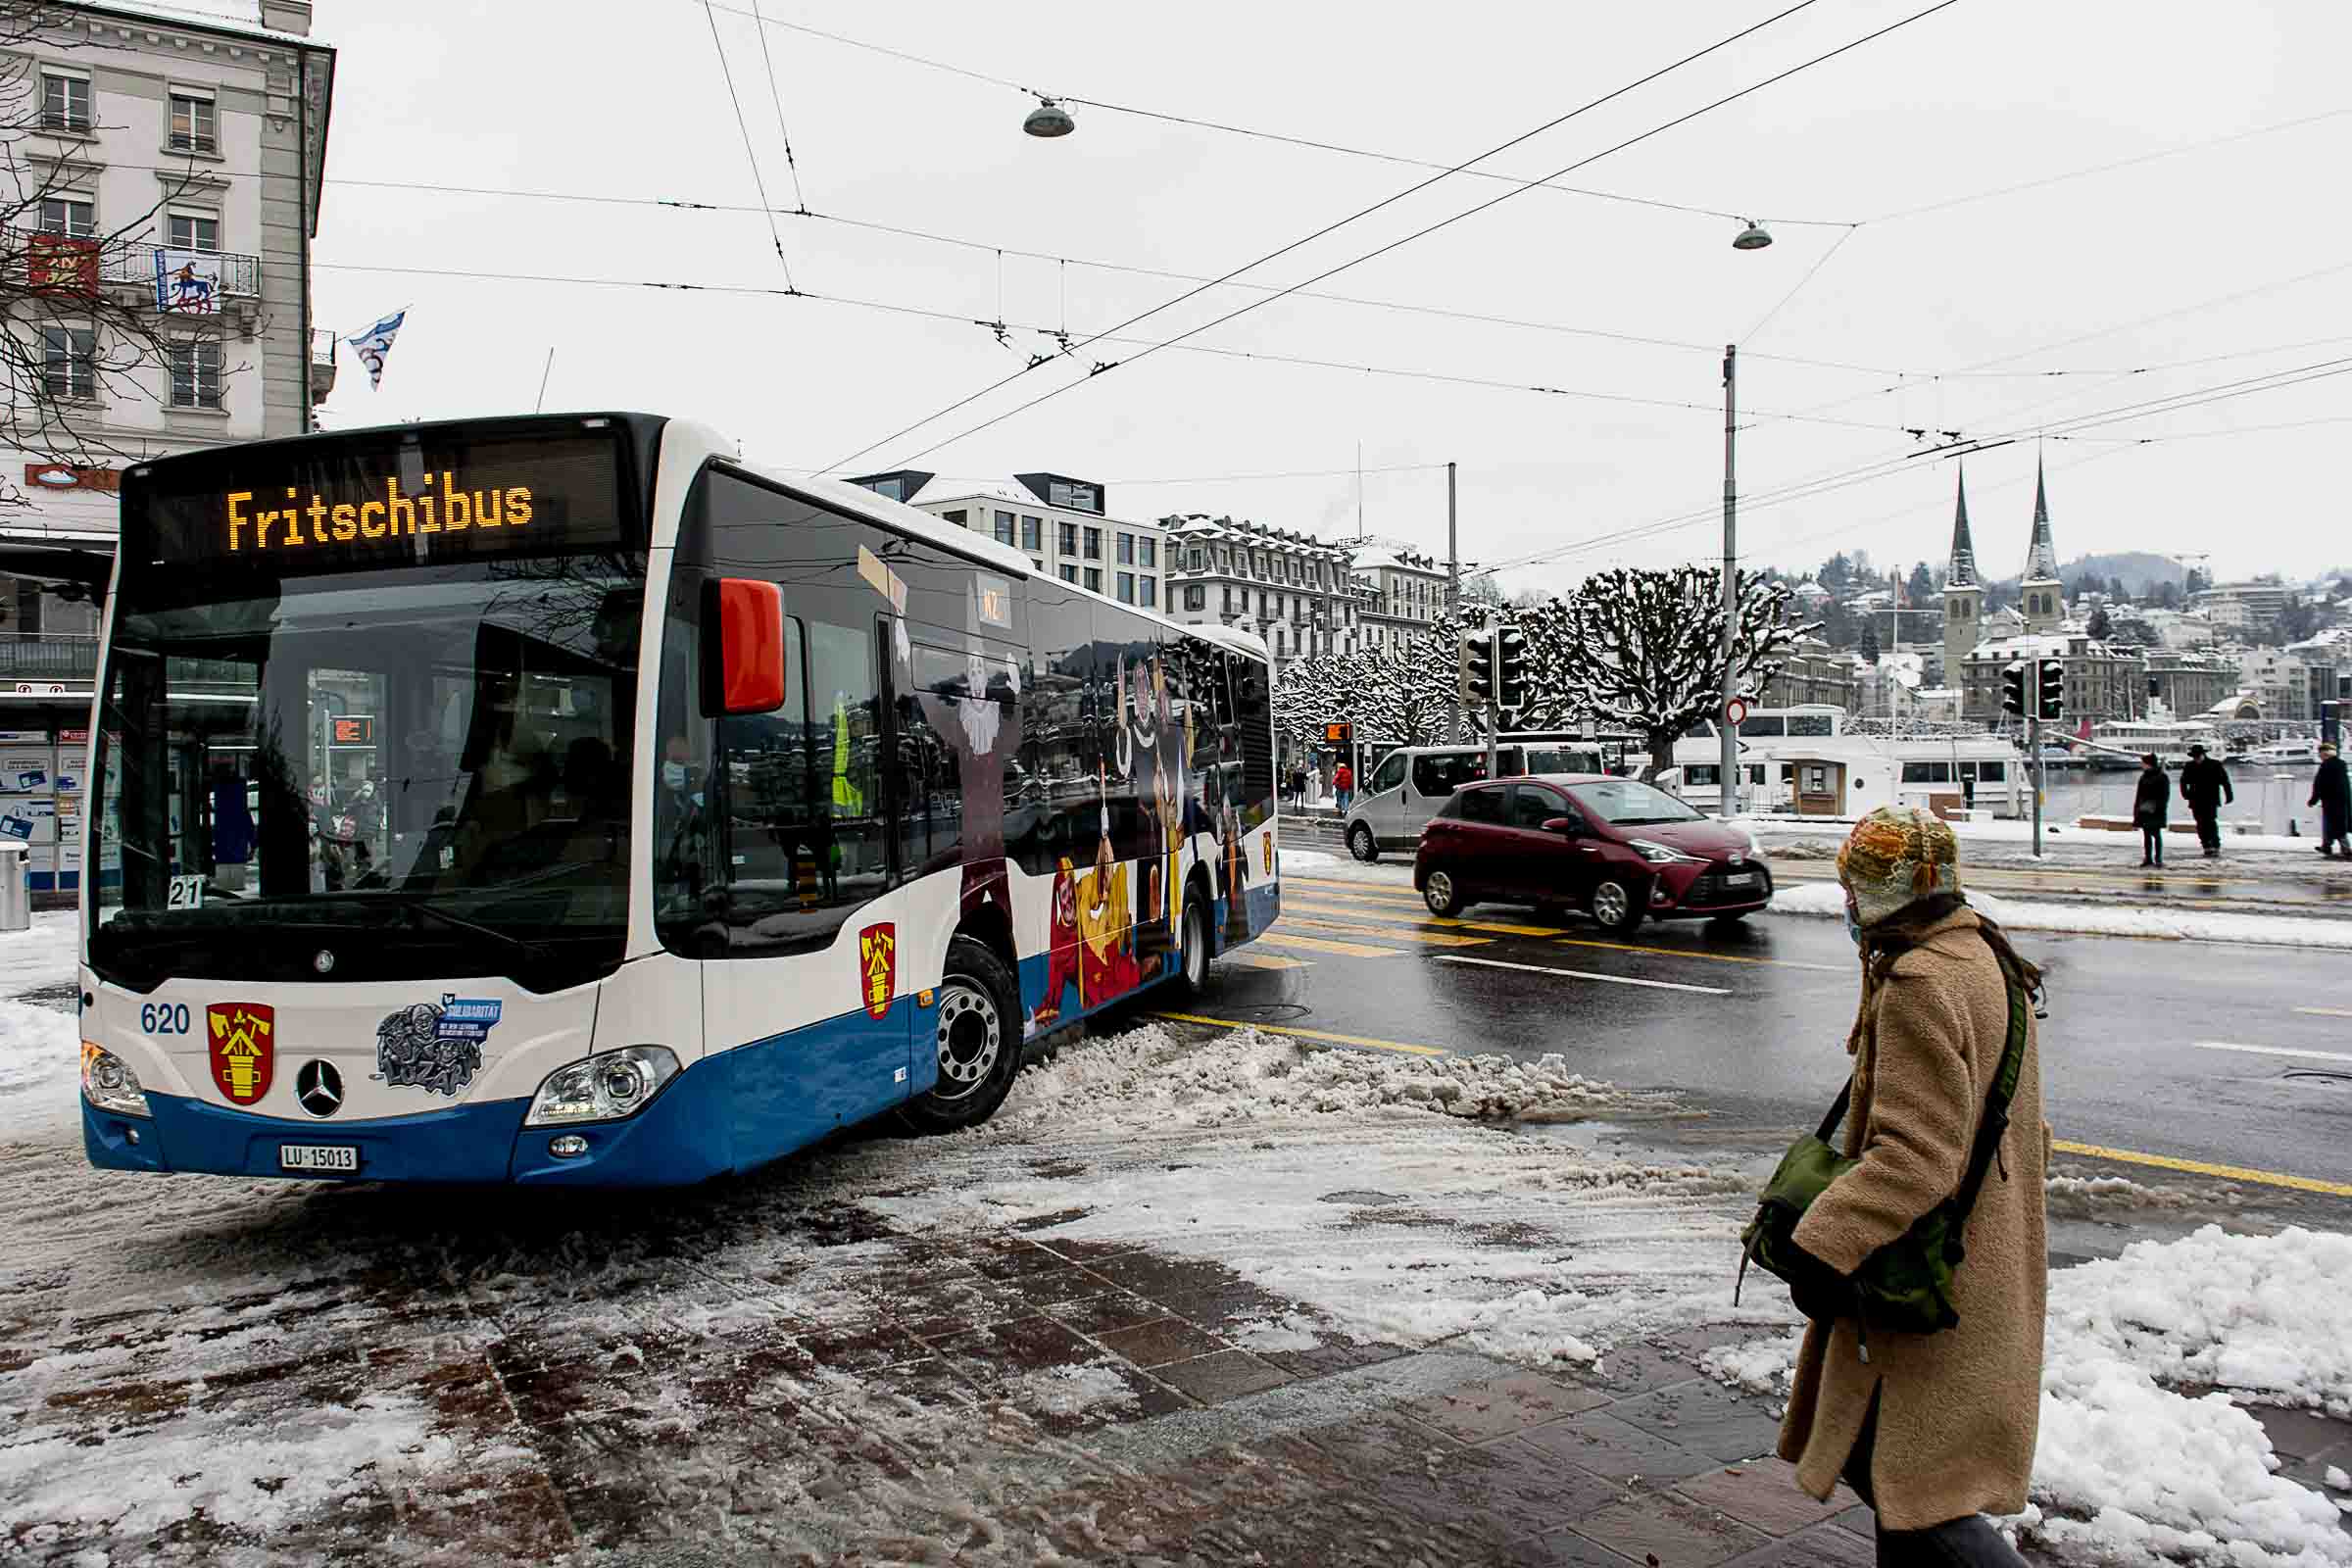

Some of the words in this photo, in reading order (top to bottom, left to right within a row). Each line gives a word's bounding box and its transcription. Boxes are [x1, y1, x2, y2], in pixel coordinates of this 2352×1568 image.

[227, 471, 533, 550] Fritschibus
[170, 881, 198, 906] 21
[141, 1003, 190, 1035] 620
